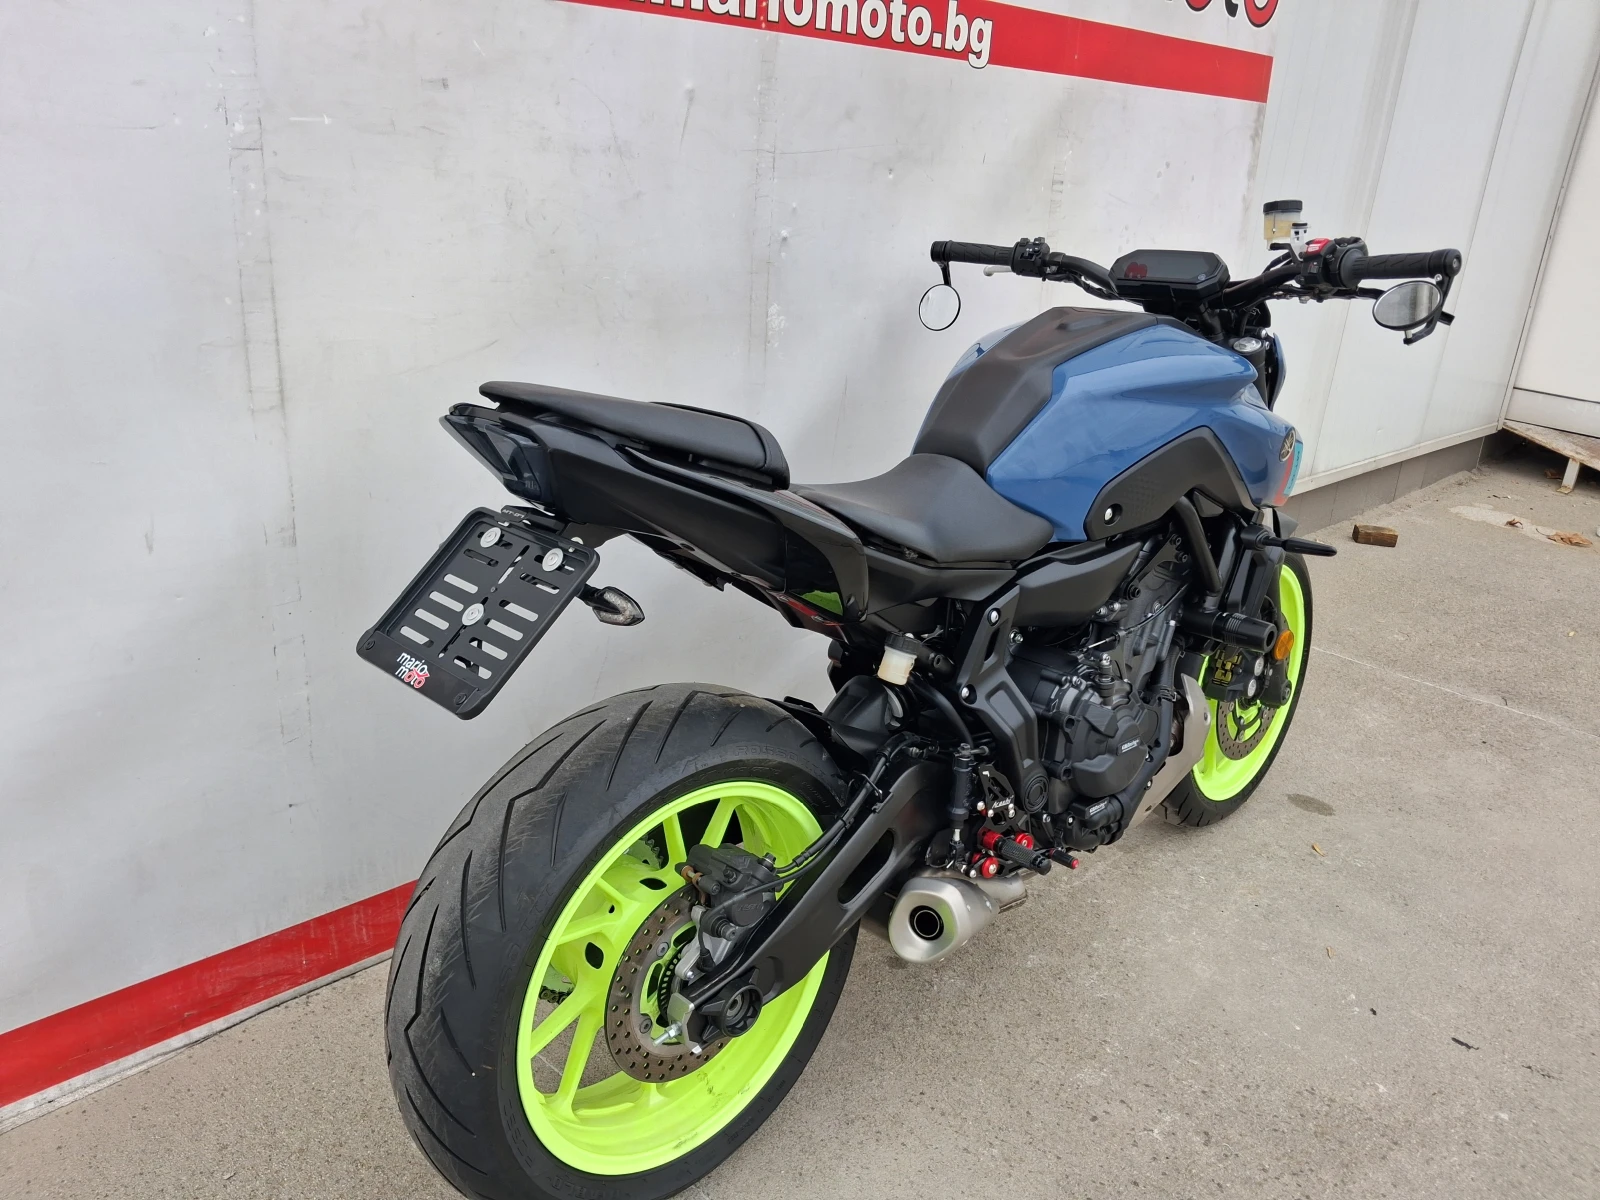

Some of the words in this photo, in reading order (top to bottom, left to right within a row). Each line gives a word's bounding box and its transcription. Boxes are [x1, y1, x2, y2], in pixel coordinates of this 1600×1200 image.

[629, 0, 994, 69] omoto.bg
[396, 652, 428, 675] mario
[395, 665, 426, 689] moto
